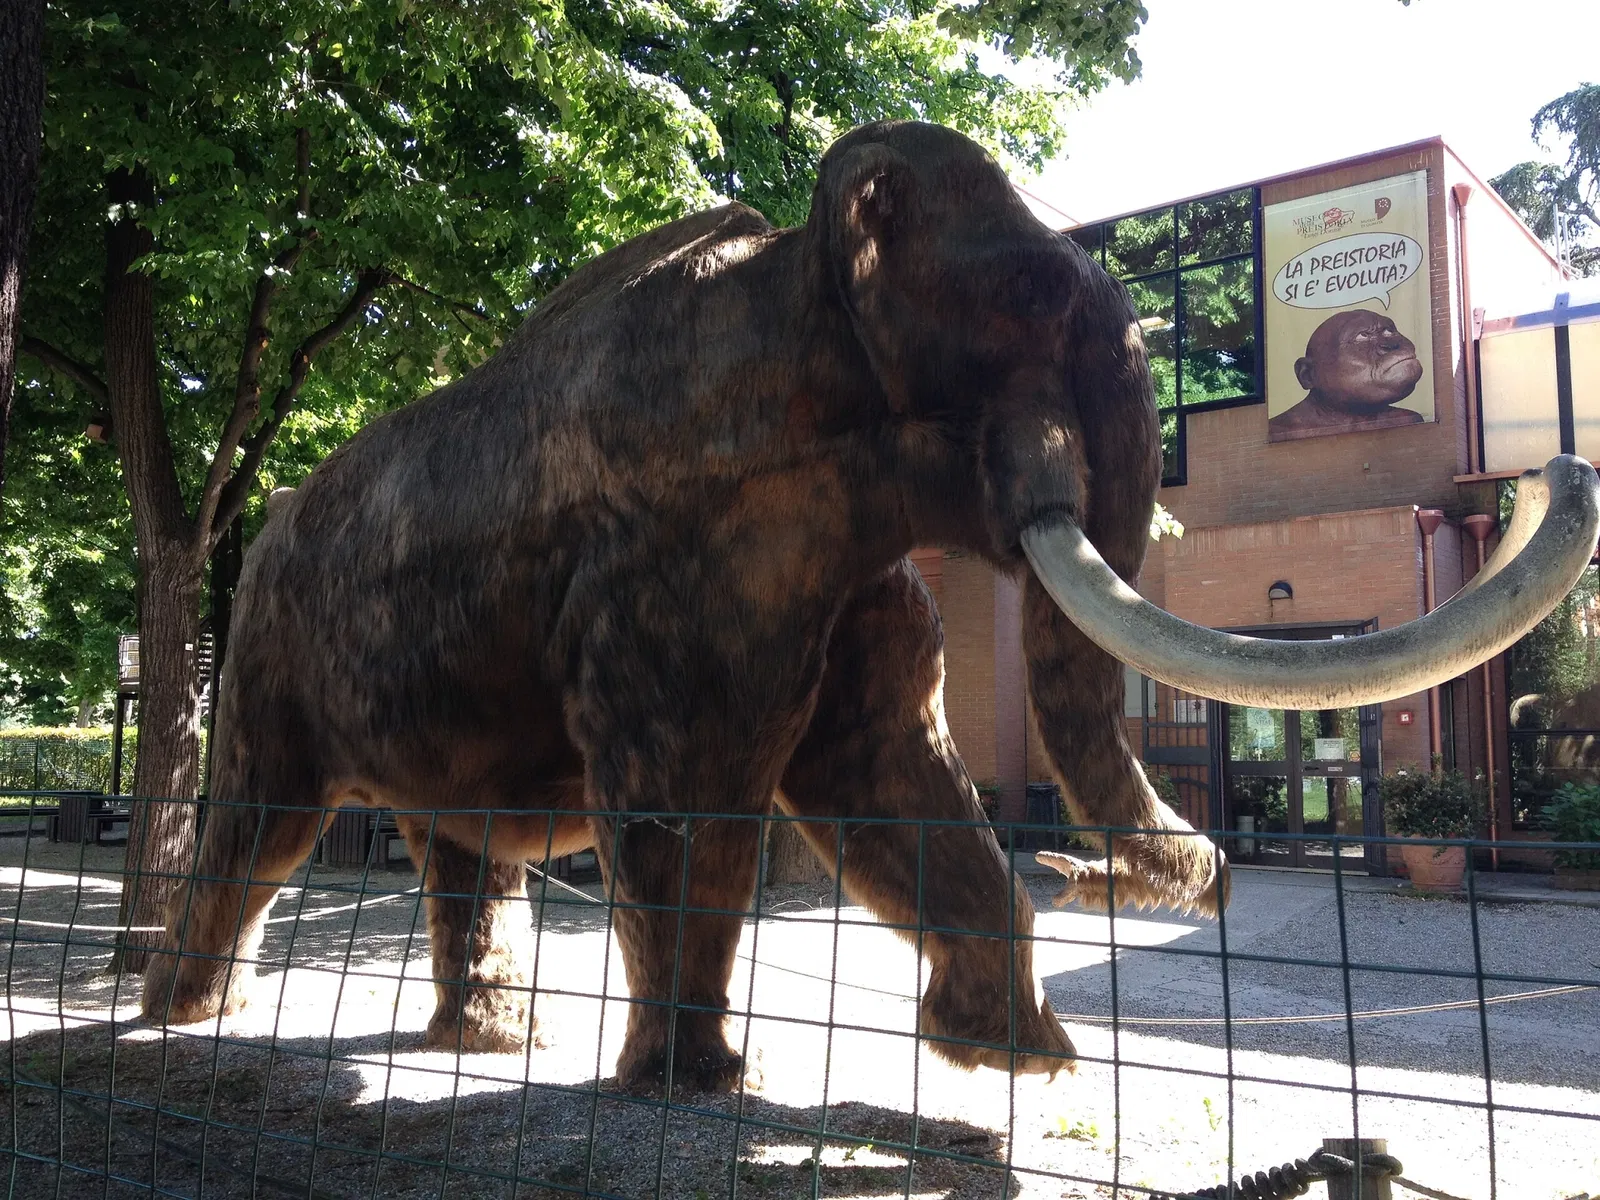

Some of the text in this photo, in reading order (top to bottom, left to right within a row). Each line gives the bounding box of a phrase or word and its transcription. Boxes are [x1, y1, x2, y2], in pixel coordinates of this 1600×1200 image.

[1293, 214, 1323, 226] MUSEO
[1285, 239, 1406, 279] LA PREISTORIA
[1285, 263, 1408, 301] SI E' EVOLUTA?
